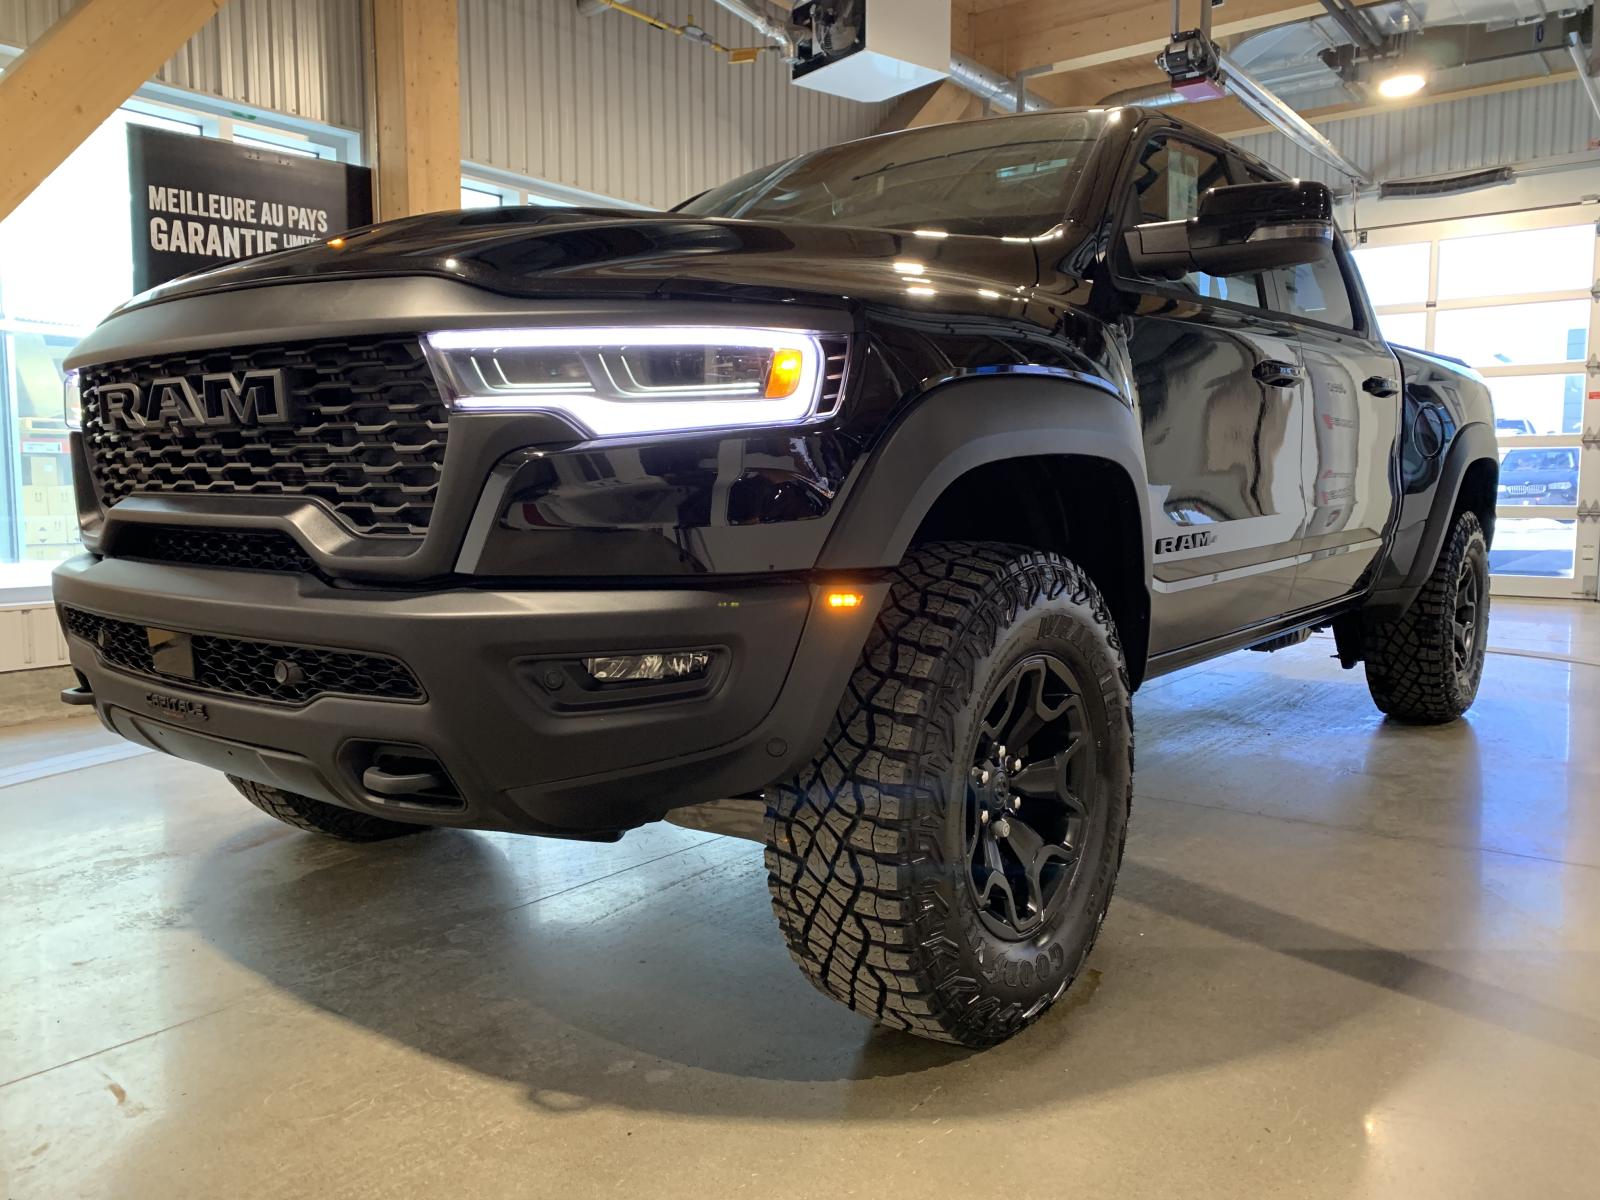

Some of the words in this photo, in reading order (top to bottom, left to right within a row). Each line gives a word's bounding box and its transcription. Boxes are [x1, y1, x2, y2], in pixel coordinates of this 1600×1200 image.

[149, 185, 255, 222] MEILLEURE
[261, 203, 284, 226] AU
[288, 206, 328, 232] PAYS
[150, 218, 278, 258] GARANTIE
[283, 234, 321, 249] LIMIT
[98, 369, 288, 431] RAM
[1155, 531, 1213, 554] RAM
